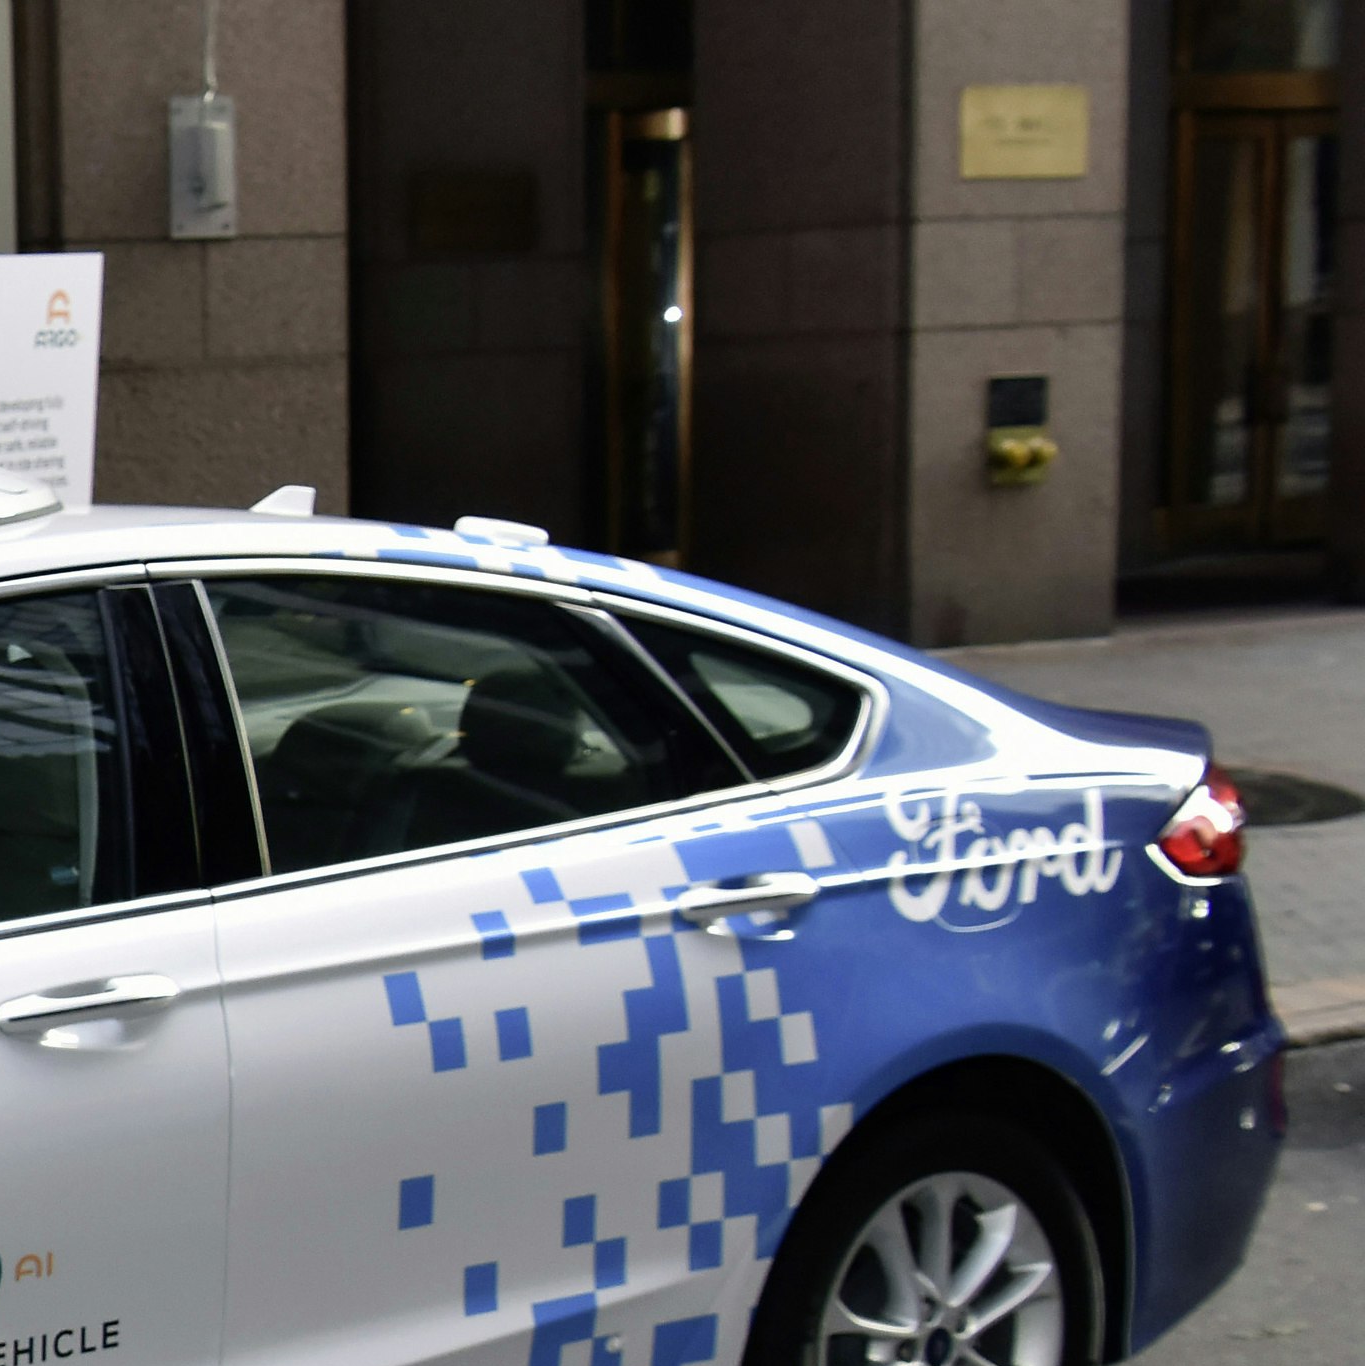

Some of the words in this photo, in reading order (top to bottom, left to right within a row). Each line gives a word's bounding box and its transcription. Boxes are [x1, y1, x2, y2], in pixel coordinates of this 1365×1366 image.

[34, 328, 78, 349] ARGO
[882, 787, 1124, 932] Ford
[14, 1251, 54, 1281] AI
